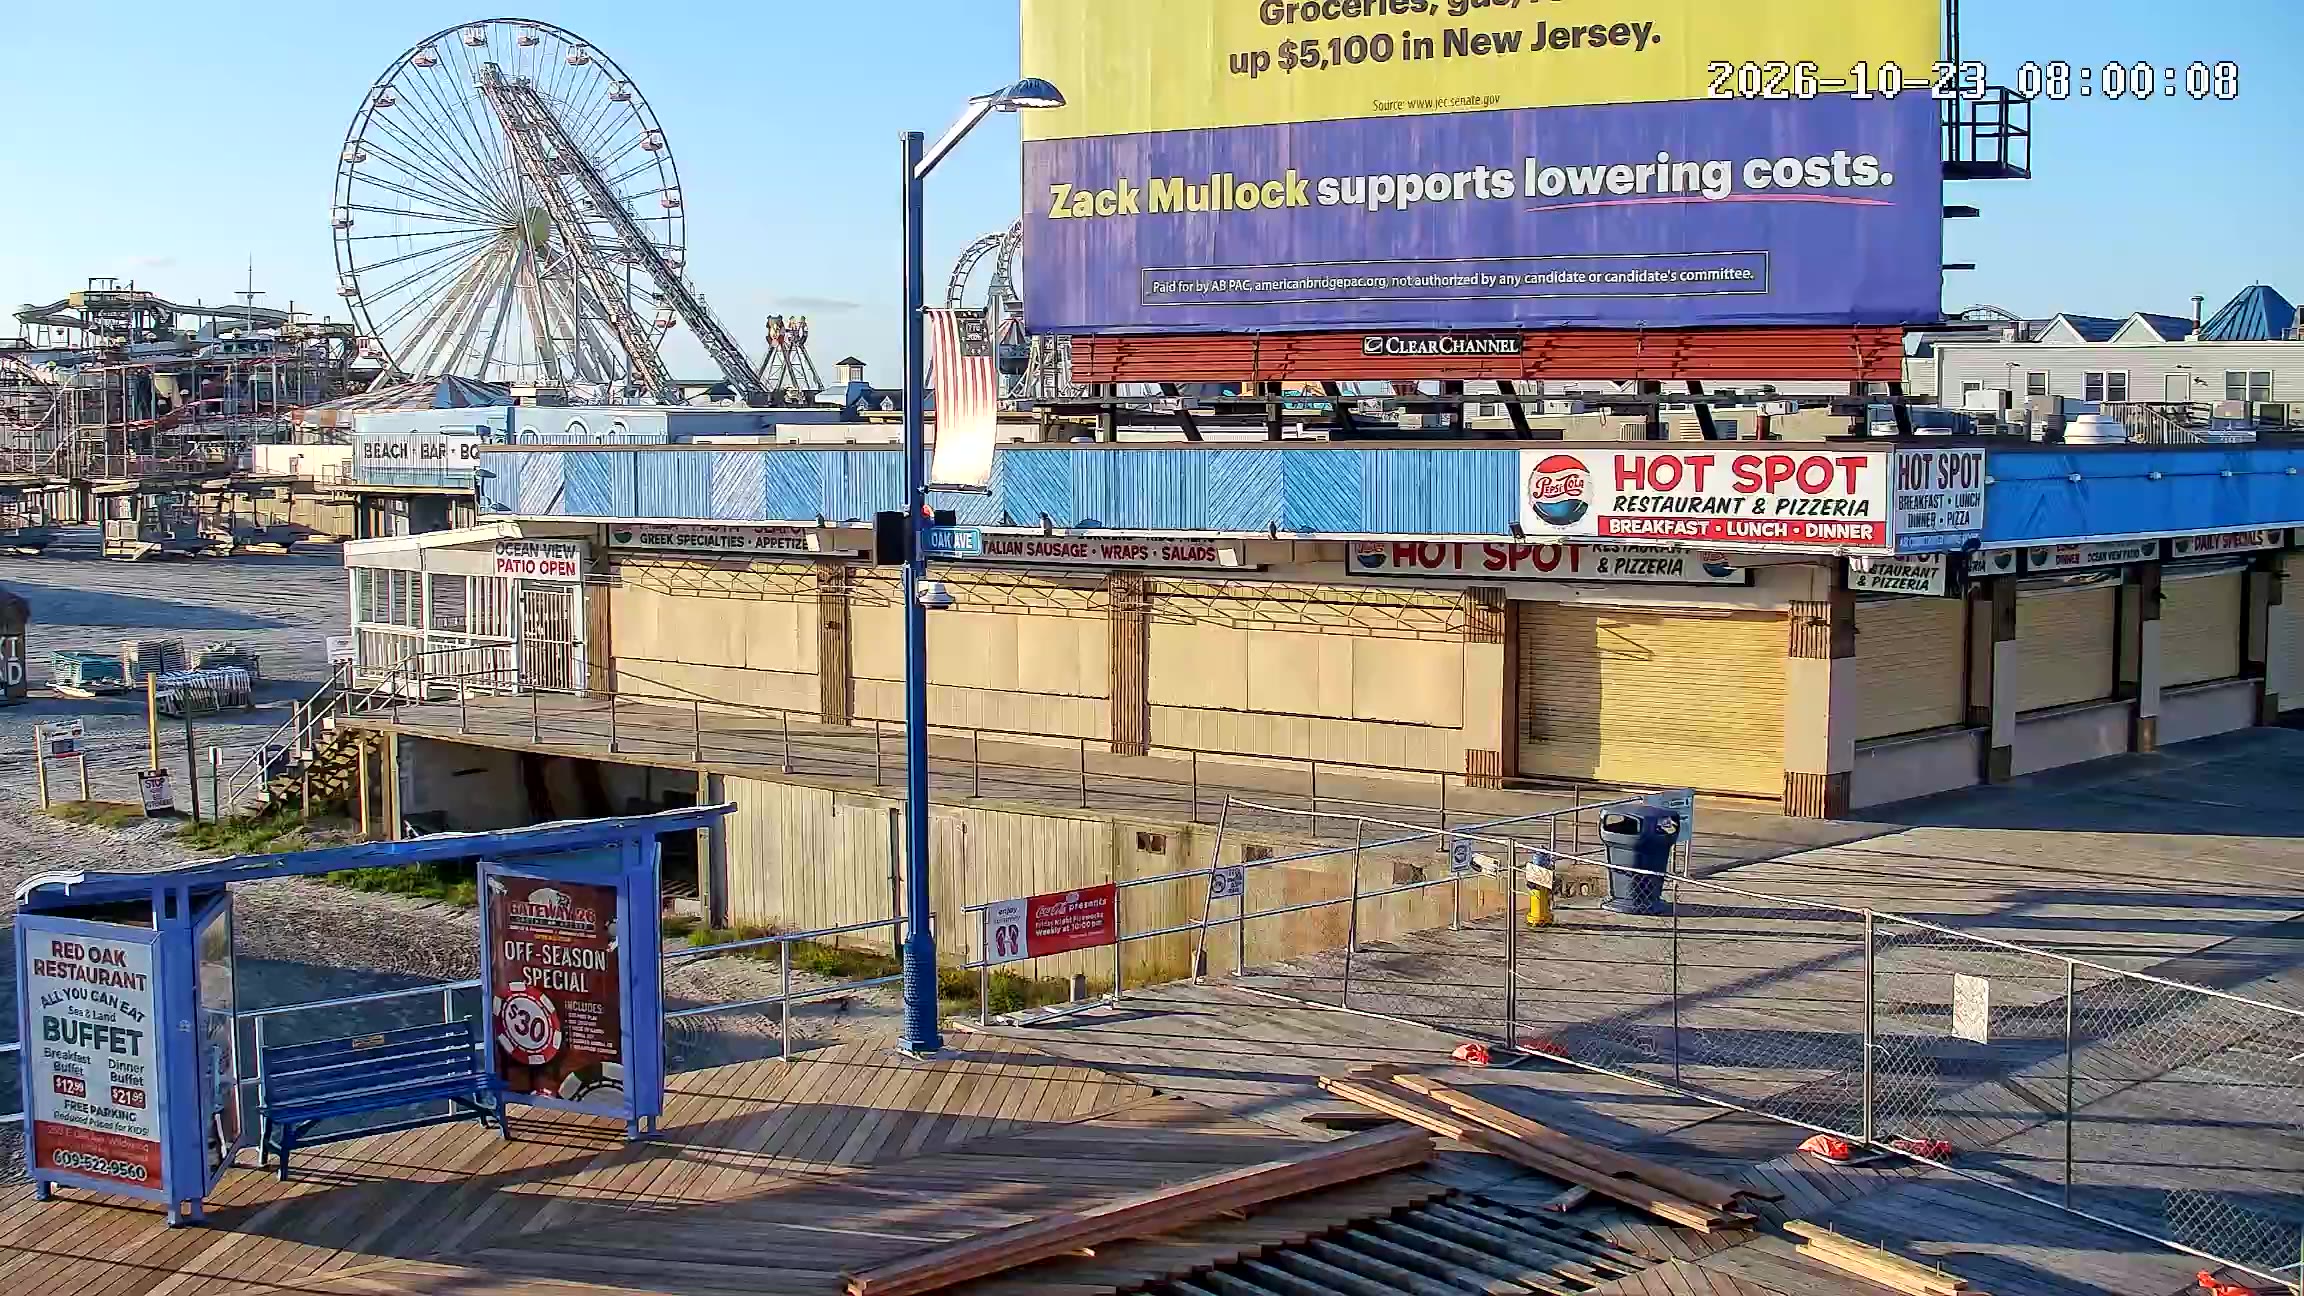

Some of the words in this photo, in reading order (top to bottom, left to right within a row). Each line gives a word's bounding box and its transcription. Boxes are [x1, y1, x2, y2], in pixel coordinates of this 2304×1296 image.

[1229, 51, 1270, 78] up
[1278, 33, 1394, 74] $5,100
[1402, 30, 1434, 61] in
[1443, 28, 1523, 57] New
[1531, 20, 1661, 52] Jersey.
[1373, 99, 1405, 112] Source:
[1048, 178, 1140, 219] Zack
[1149, 168, 1312, 214] Mullock
[1317, 161, 1516, 211] supports
[1524, 152, 1733, 199] lowering
[1743, 149, 1894, 188] costs.
[1153, 280, 1176, 293] Paid
[1178, 280, 1193, 292] for
[1196, 280, 1210, 295] by
[1211, 280, 1226, 292] AB
[1229, 279, 1253, 293] PAC,
[1254, 275, 1389, 291] americanbridgepac.org,
[1391, 275, 1412, 287] not
[1414, 272, 1479, 286] authorized
[1481, 272, 1498, 288] by
[1499, 274, 1522, 288] any
[1524, 270, 1586, 284] candidate
[1589, 273, 1602, 283] or
[1604, 269, 1677, 283] candidate's
[1680, 267, 1754, 281] committee.
[363, 442, 408, 459] BEACH
[421, 442, 446, 459] BAR
[1614, 454, 1715, 494] HOT
[1732, 454, 1868, 496] SPOT
[1898, 453, 1933, 490] HOT
[1938, 453, 1982, 490] SPOT
[1612, 496, 1740, 516] RESTAURANT
[1752, 496, 1766, 516] &
[1775, 497, 1869, 517] PIZZERIA
[1898, 494, 1944, 510] BREAKFAST
[1955, 492, 1980, 508] LUNCH
[1609, 518, 1710, 536] BREAKFAST
[1726, 520, 1788, 538] LUNCH
[1805, 522, 1873, 540] DINNER
[1908, 512, 1936, 528] DINNER
[1947, 510, 1970, 526] PIZZA
[495, 542, 539, 557] OCEAN
[543, 543, 577, 559] VIEW
[640, 532, 674, 546] GREEK
[676, 533, 745, 548] SPECIALTIES
[755, 536, 809, 550] APPETIZE
[931, 531, 952, 549] OAK
[953, 531, 973, 550] AVE
[982, 539, 1026, 556] TALIAN
[1026, 541, 1087, 558] SAUSAGE
[1100, 543, 1149, 560] WRAPS
[1161, 545, 1215, 562] SALADS
[2194, 535, 2221, 551] DAILY
[497, 558, 535, 575] PATIO
[539, 560, 577, 577] OPEN
[1391, 542, 1474, 569] HOT
[1483, 543, 1592, 573] SPOT
[1597, 559, 1609, 574] &
[1614, 557, 1683, 576] PIZZERIA
[1871, 563, 1940, 579] STAURANT
[1856, 575, 1867, 587] &
[1872, 576, 1930, 592] PIZZERIA
[52, 940, 85, 961] RED
[88, 946, 128, 967] OAK
[504, 940, 607, 971] OFF-SEASON
[34, 959, 147, 992] RESTAURANT
[522, 966, 589, 993] SPECIAL
[41, 990, 64, 1009] ALL
[63, 987, 88, 1000] YOU
[91, 990, 119, 1009] CAN
[120, 1000, 145, 1023] EAT
[68, 1005, 83, 1017] Sea
[92, 1009, 117, 1022] Land
[508, 1003, 546, 1043] $30
[43, 1015, 144, 1057] BUFFET
[44, 1047, 92, 1065] Breakfast
[108, 1058, 145, 1074] Dinner
[53, 1060, 85, 1076] Buffet
[110, 1071, 144, 1087] Buffet
[64, 1099, 89, 1114] FREE
[90, 1104, 137, 1122] PARKING
[53, 1148, 148, 1182] 609-522-9560
